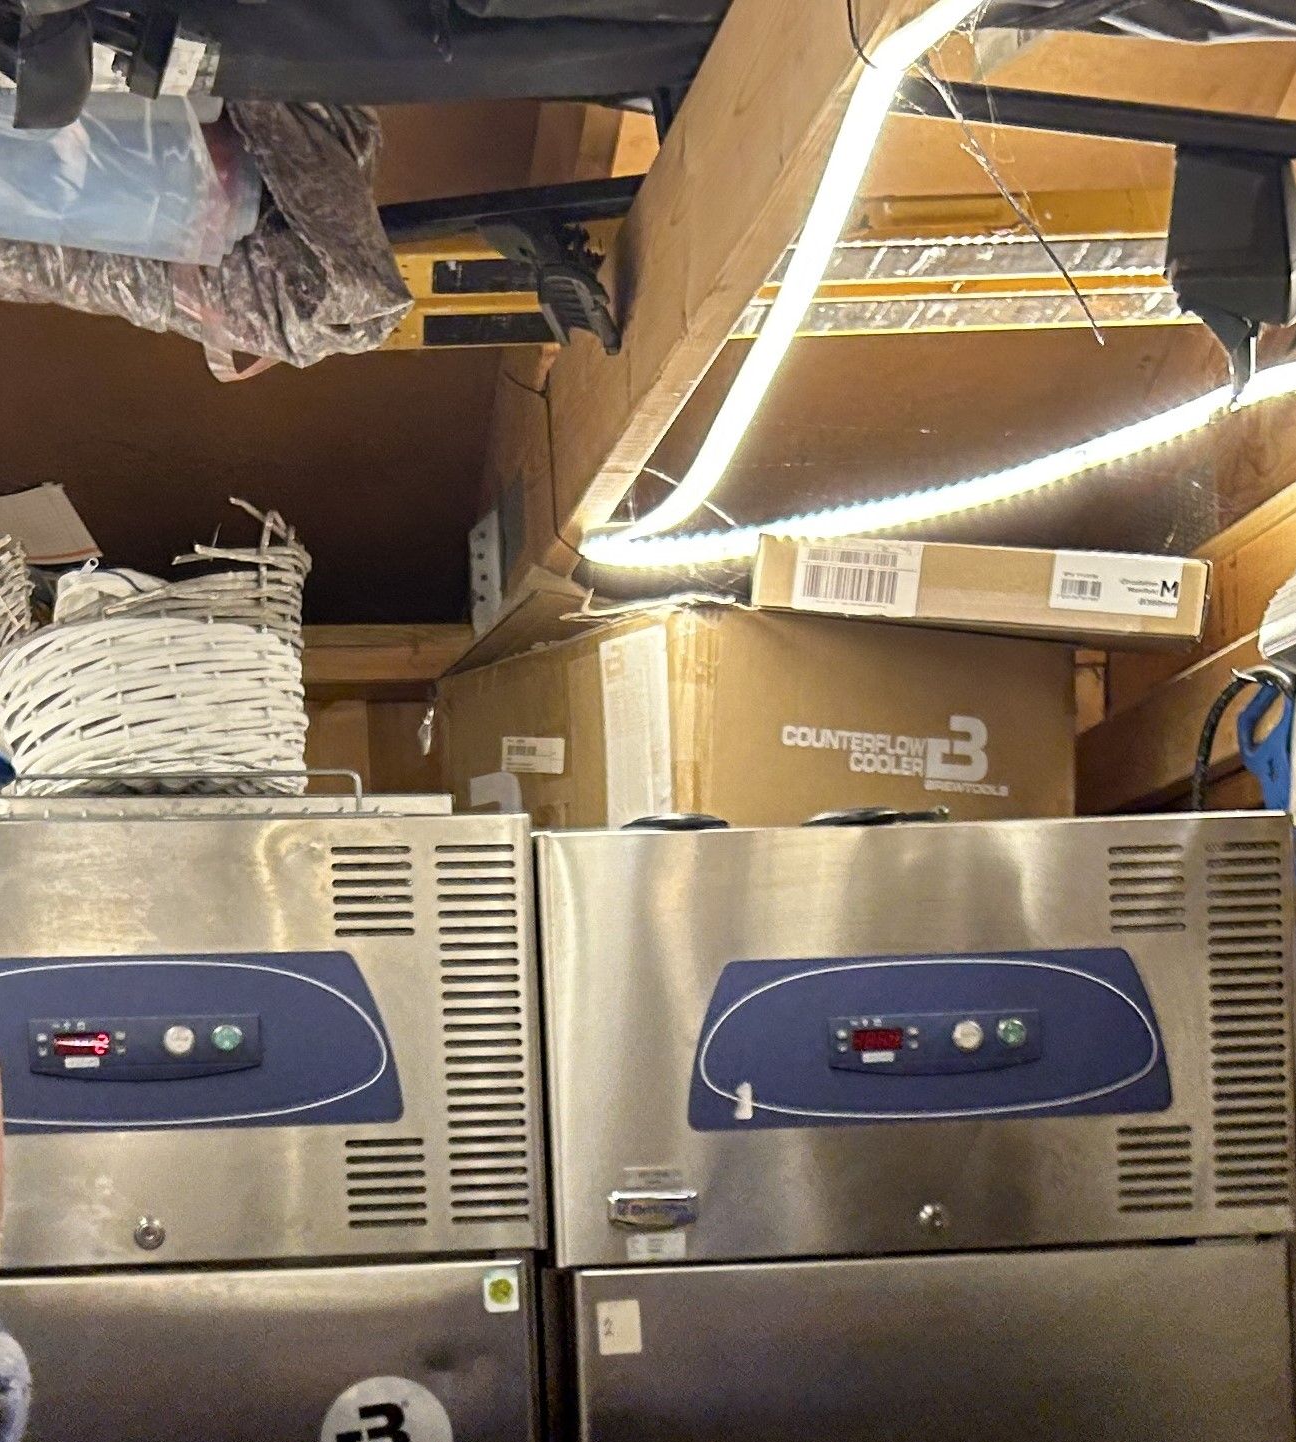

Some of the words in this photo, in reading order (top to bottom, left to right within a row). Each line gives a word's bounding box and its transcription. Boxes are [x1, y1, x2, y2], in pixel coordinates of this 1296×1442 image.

[1160, 580, 1180, 598] M
[782, 725, 925, 757] COUNTERFLOW
[849, 751, 925, 777] COOLER
[923, 779, 1010, 797] BREWTOOLS
